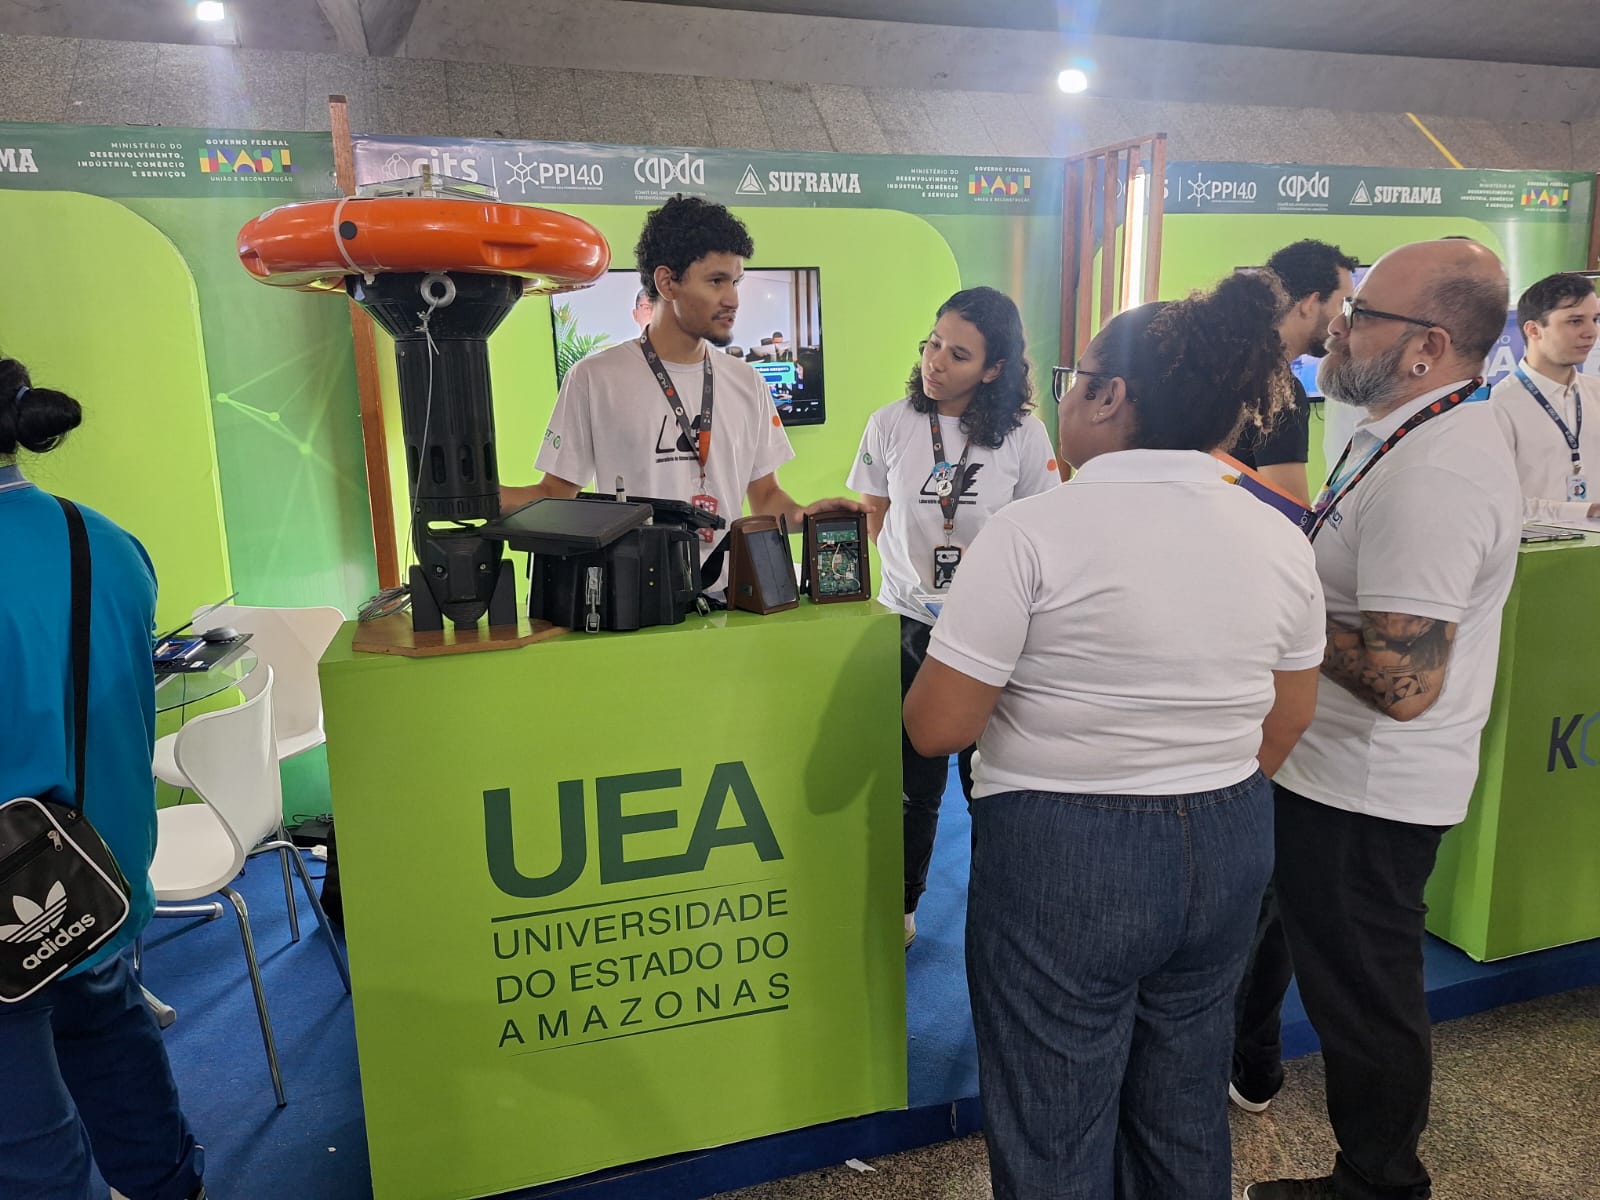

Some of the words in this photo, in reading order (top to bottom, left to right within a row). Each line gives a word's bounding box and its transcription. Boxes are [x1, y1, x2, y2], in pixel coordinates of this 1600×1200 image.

[90, 151, 184, 159] DESENVOLVIMENTO,
[111, 141, 166, 150] MINISTÉRIO
[136, 159, 185, 168] COMÉRCIO
[768, 171, 862, 195] SUFRAMA
[1374, 186, 1442, 204] SUFRAMA
[482, 760, 785, 899] UEA
[22, 913, 96, 970] adidas
[493, 889, 789, 960] UNIVERSIDADE
[496, 969, 556, 1005] DO
[570, 942, 723, 992] ESTADO
[736, 931, 789, 964] DO
[498, 972, 790, 1048] AMAZONAS
